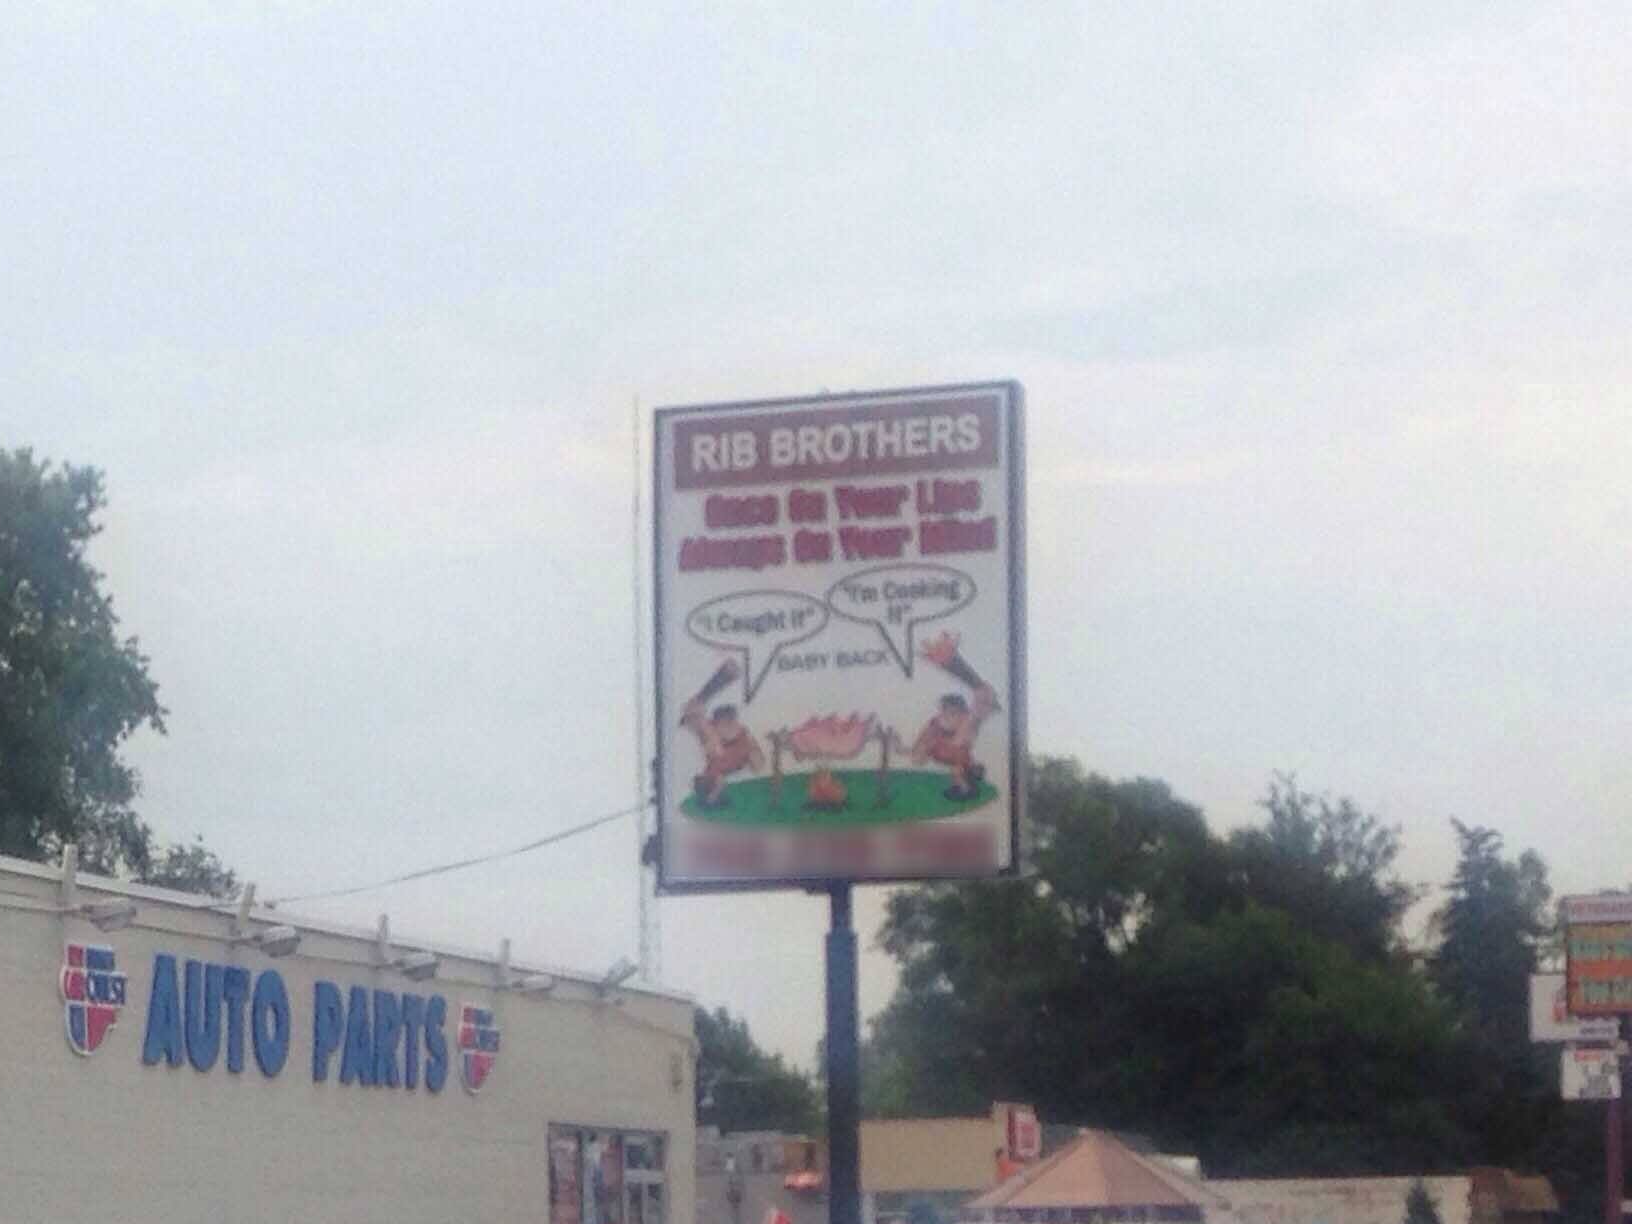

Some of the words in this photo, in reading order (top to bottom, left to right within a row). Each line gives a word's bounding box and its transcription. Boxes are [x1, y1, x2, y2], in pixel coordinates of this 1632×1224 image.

[691, 431, 759, 473] RIB
[769, 413, 981, 467] BROTHERS
[142, 951, 291, 1079] AUTO
[312, 980, 449, 1094] PARTS
